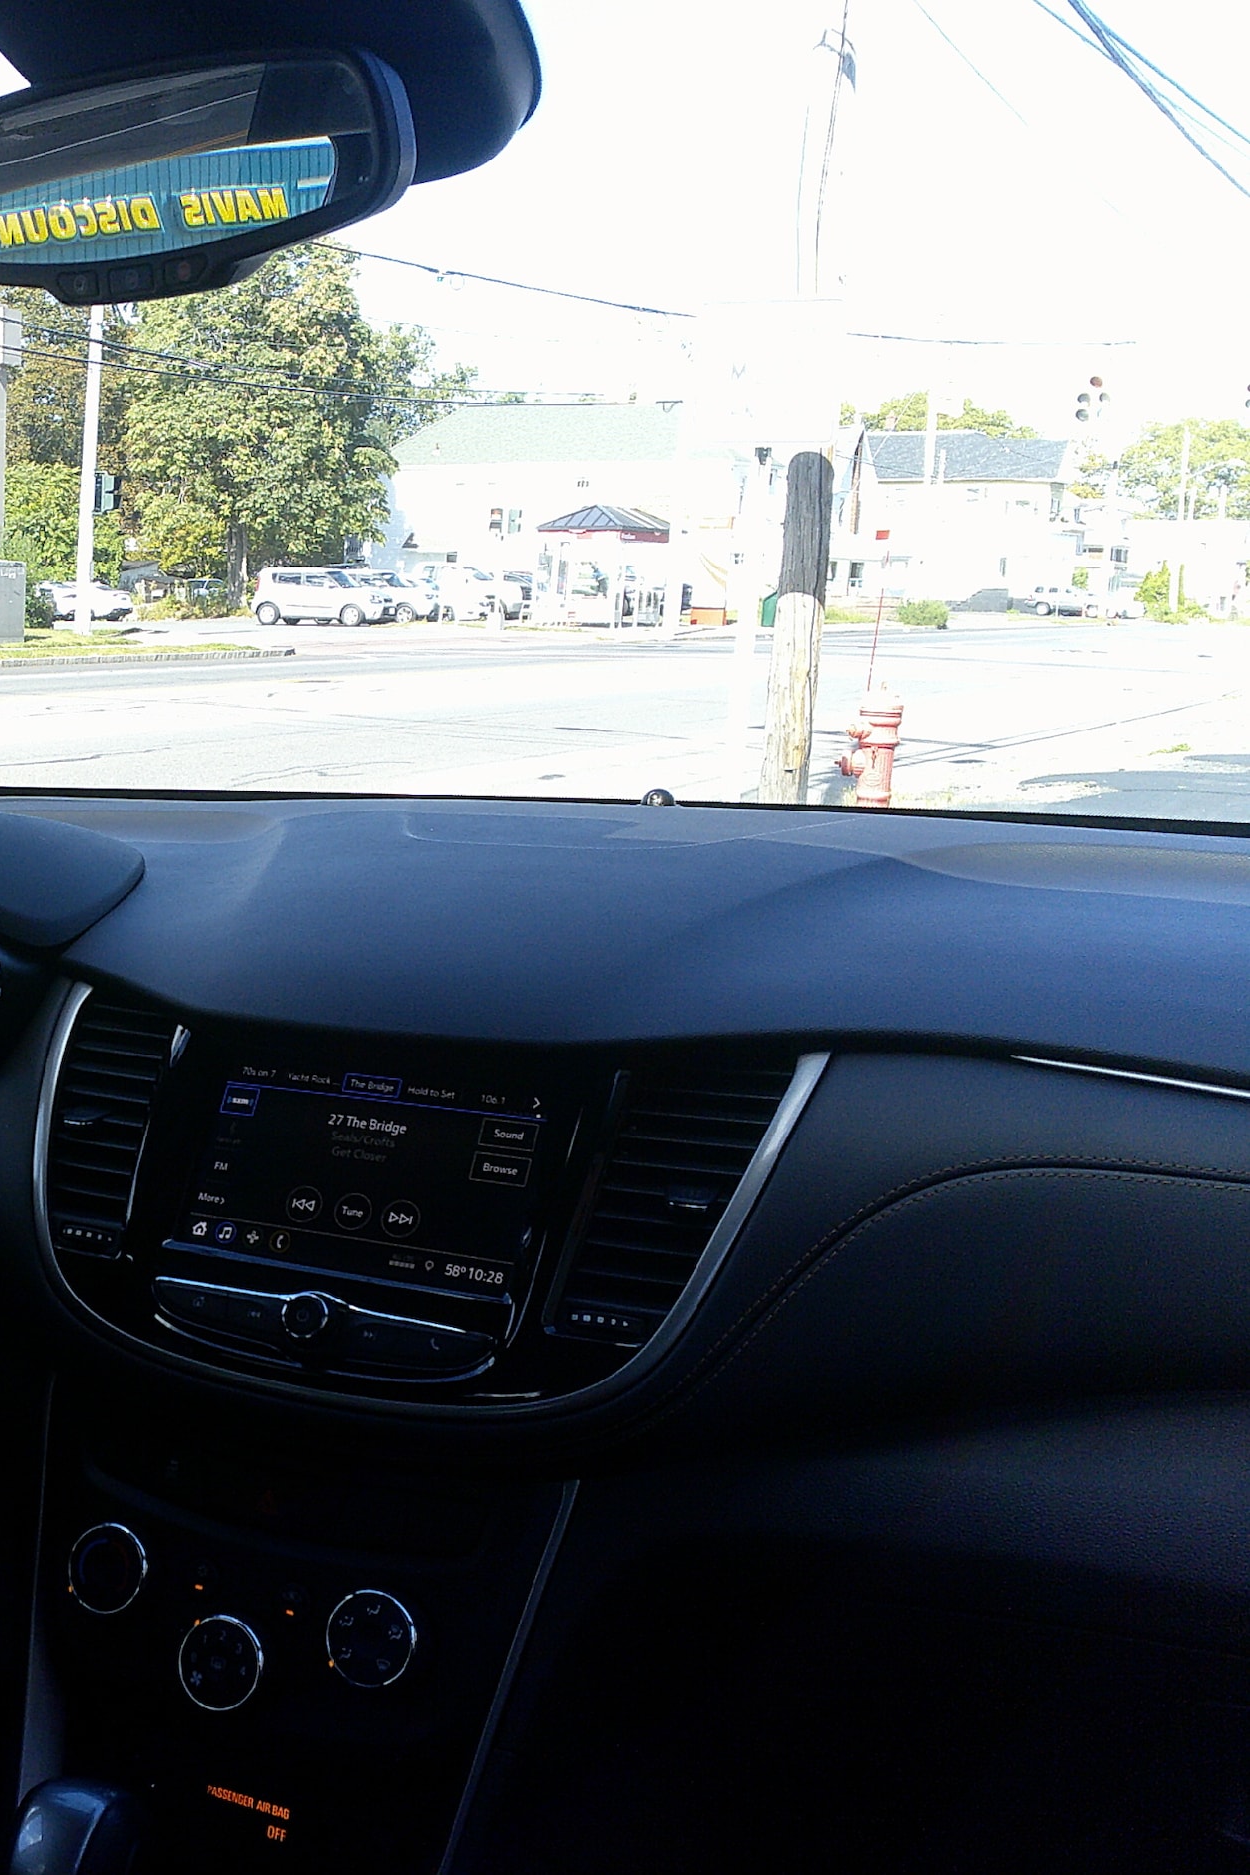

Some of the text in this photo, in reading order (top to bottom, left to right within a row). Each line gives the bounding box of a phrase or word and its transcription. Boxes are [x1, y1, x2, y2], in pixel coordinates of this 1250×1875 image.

[257, 1069, 268, 1077] on
[270, 1069, 277, 1078] 7
[350, 1079, 395, 1093] The Bridge
[408, 1086, 455, 1099] Hold to Set
[480, 1094, 506, 1105] 106.1
[328, 1113, 407, 1137] 27 The Bridge
[493, 1129, 525, 1141] Sound
[331, 1146, 352, 1159] Get
[213, 1160, 229, 1173] FM
[482, 1162, 519, 1176] Browse
[197, 1191, 220, 1205] More
[341, 1205, 364, 1220] Tune
[467, 1265, 505, 1284] 10:28
[206, 1784, 291, 1821] PASSENGER AIR BAG
[267, 1824, 287, 1843] OFF
